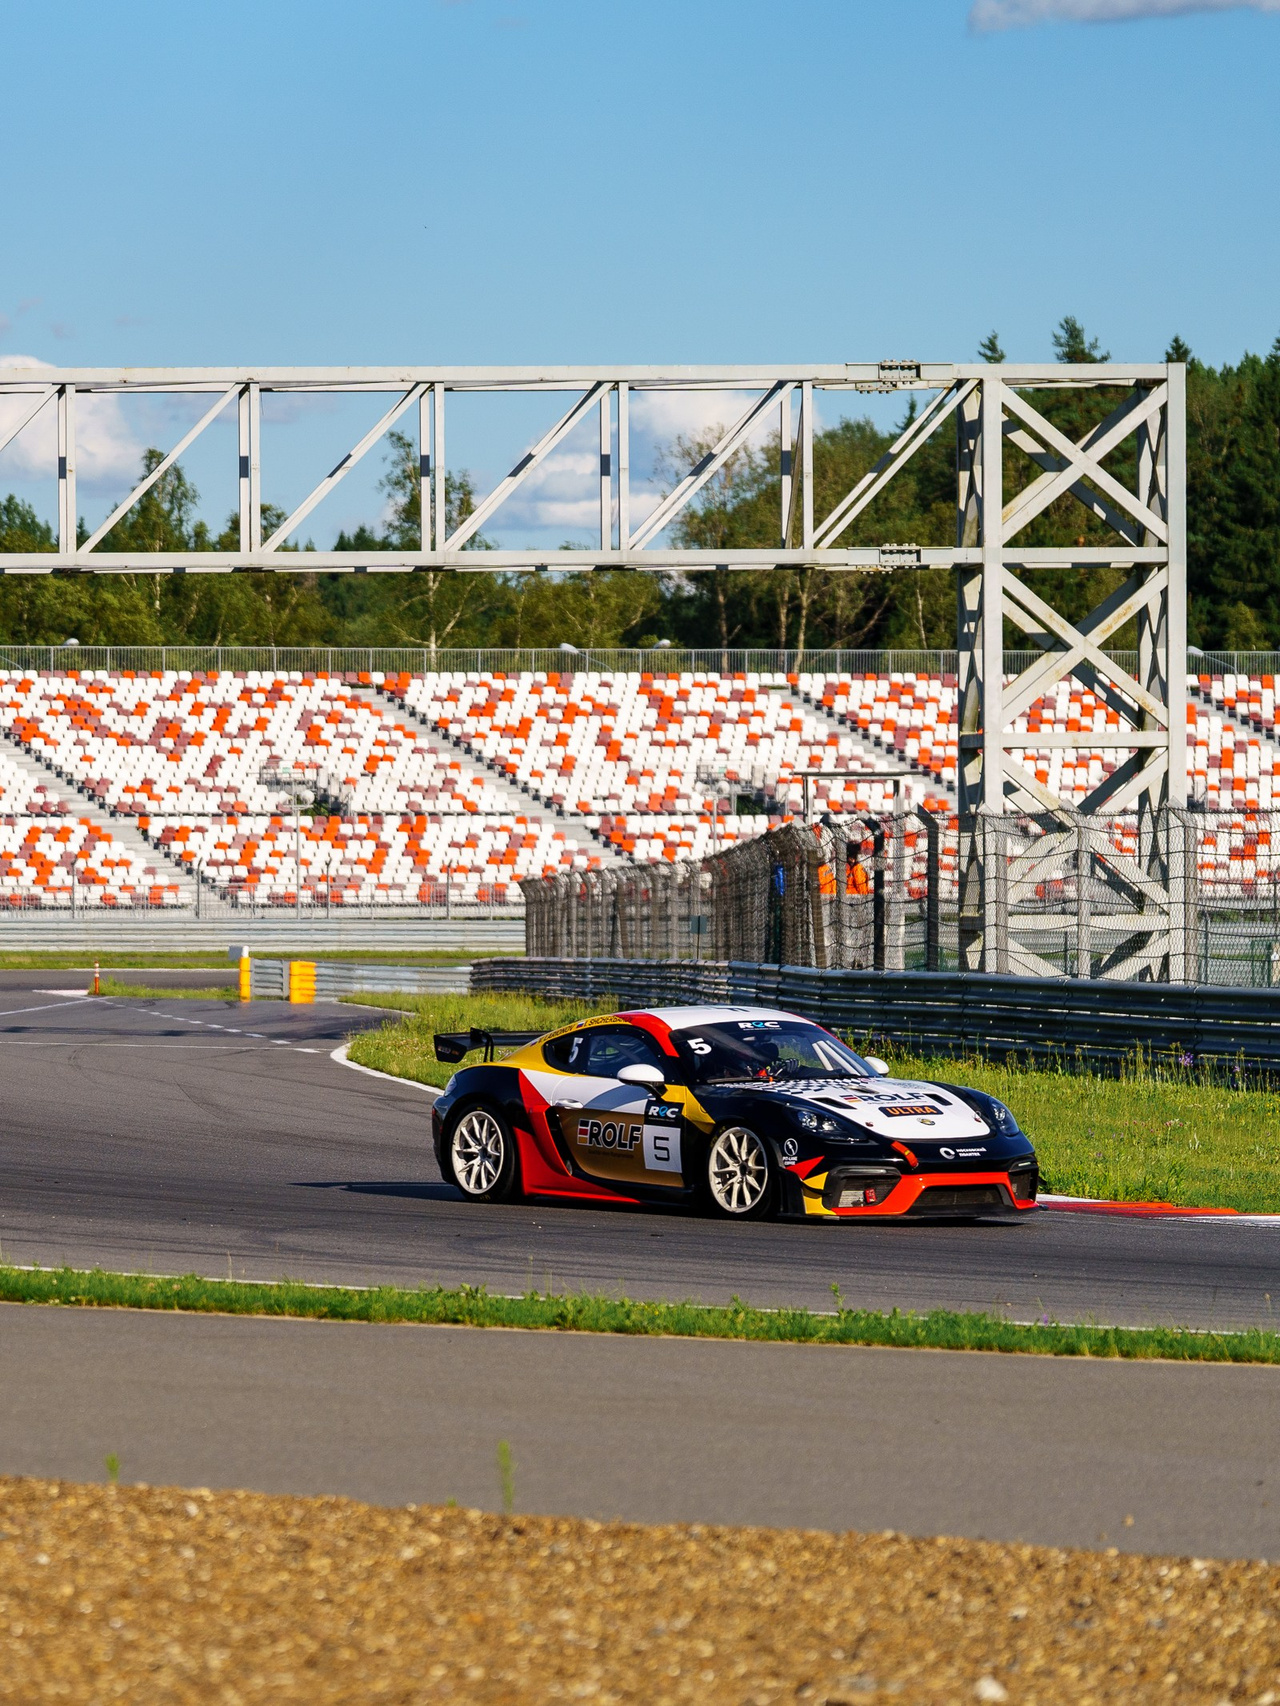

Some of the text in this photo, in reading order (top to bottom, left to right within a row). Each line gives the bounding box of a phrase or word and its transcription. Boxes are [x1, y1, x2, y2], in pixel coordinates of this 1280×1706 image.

[568, 1037, 584, 1063] 5
[687, 1038, 712, 1054] 5
[859, 1092, 926, 1102] ROLF
[886, 1105, 937, 1115] ULTRA
[588, 1119, 642, 1151] ROLF
[653, 1136, 670, 1161] 5
